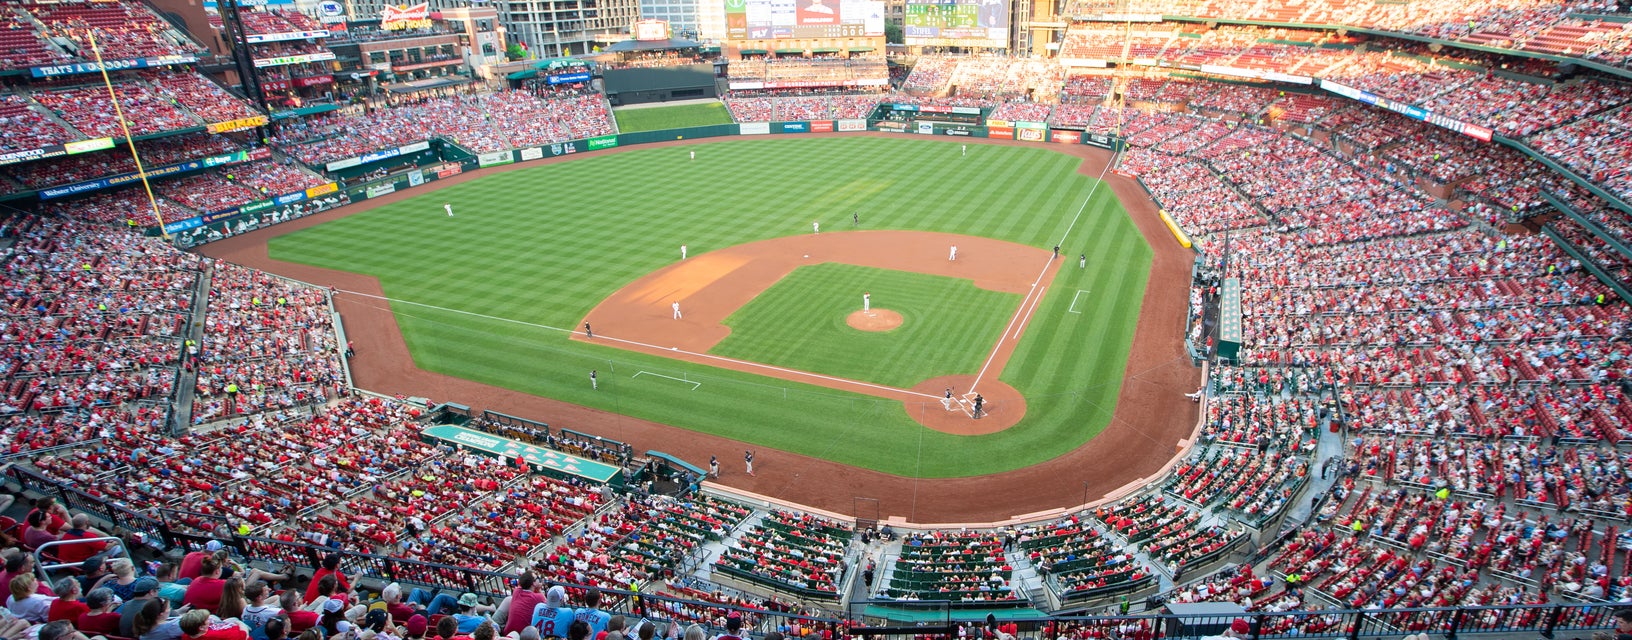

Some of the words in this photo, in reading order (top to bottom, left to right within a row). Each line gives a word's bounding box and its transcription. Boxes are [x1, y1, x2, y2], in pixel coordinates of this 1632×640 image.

[40, 65, 73, 76] THAT'S
[216, 122, 235, 133] BIG
[237, 117, 263, 128] MAC
[44, 187, 70, 197] Webster
[71, 182, 101, 193] University
